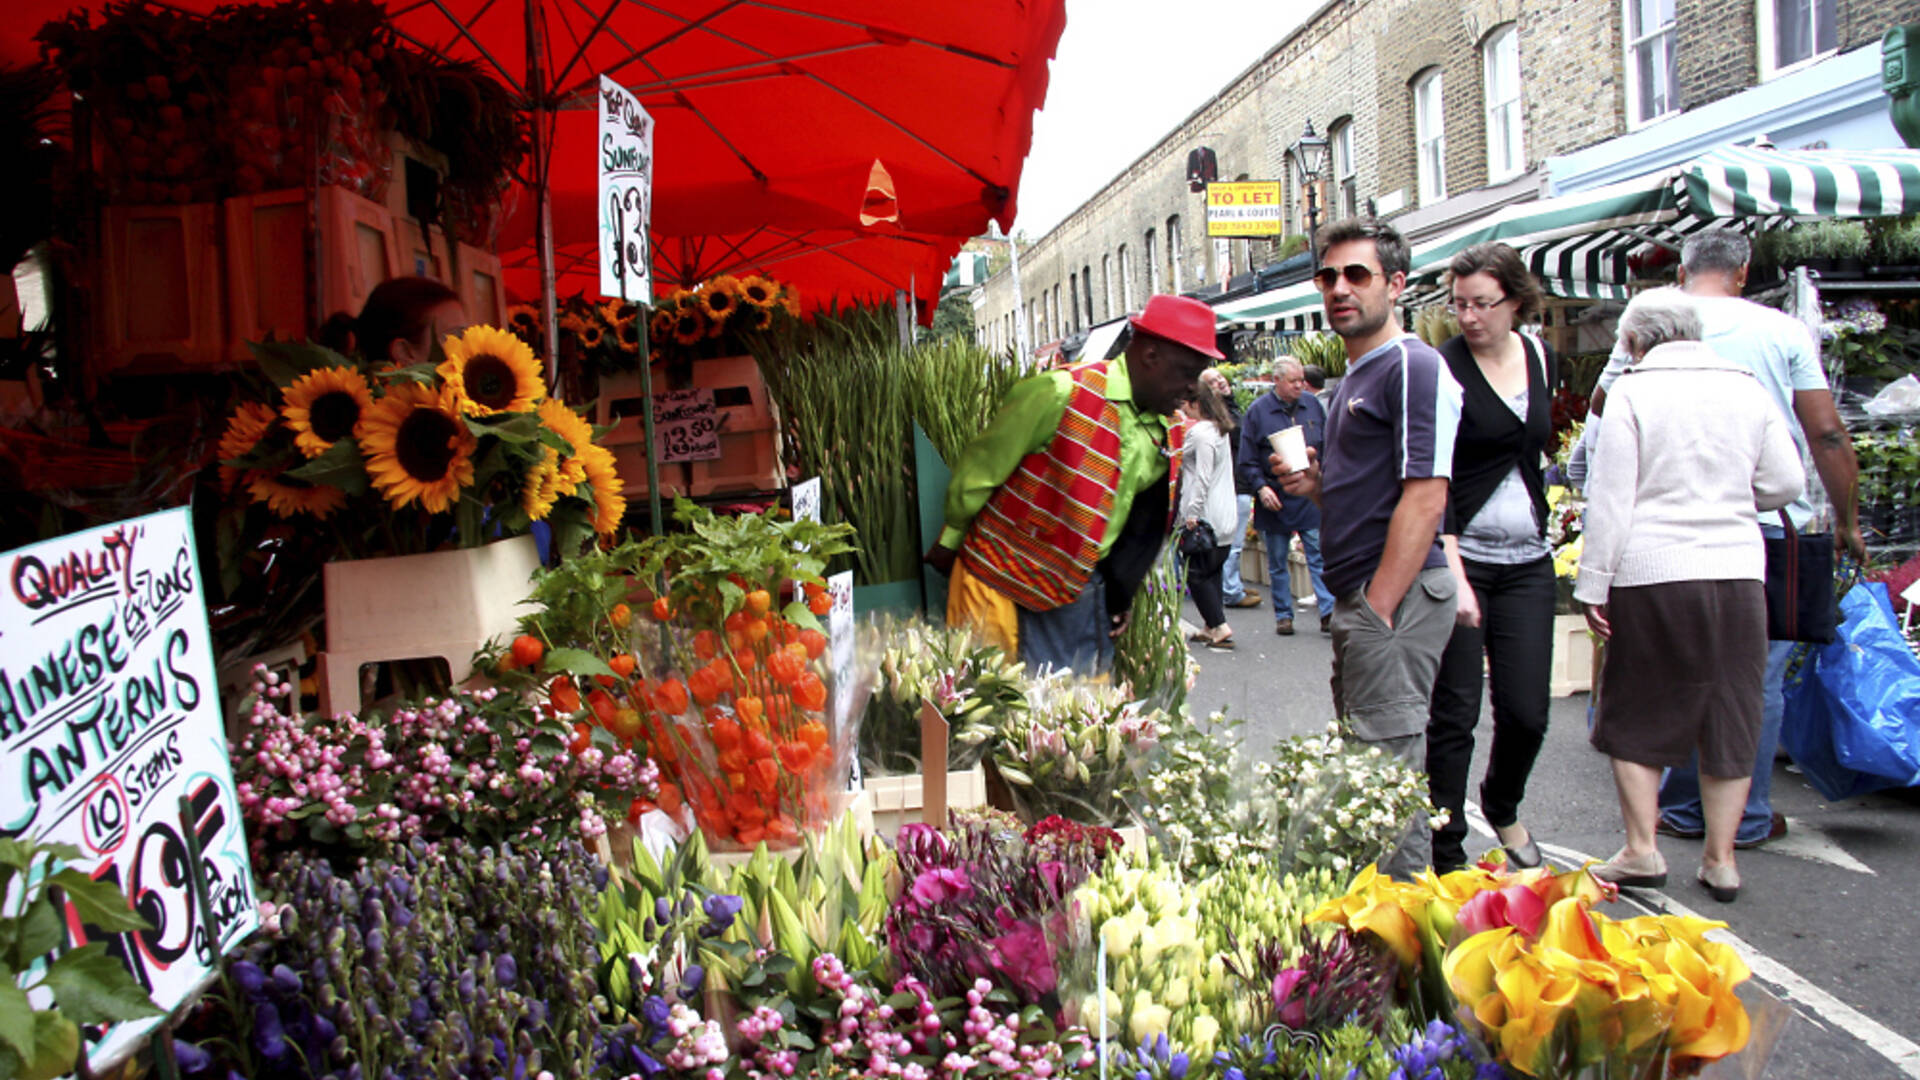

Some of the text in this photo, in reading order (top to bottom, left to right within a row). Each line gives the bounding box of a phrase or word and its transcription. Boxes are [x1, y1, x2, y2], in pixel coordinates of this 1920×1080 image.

[1211, 192, 1273, 205] TO LET
[1247, 207, 1281, 217] COUTTS
[10, 524, 139, 609] QUALITY
[89, 729, 183, 838] 10 STEMS
[196, 866, 252, 966] BNCH
